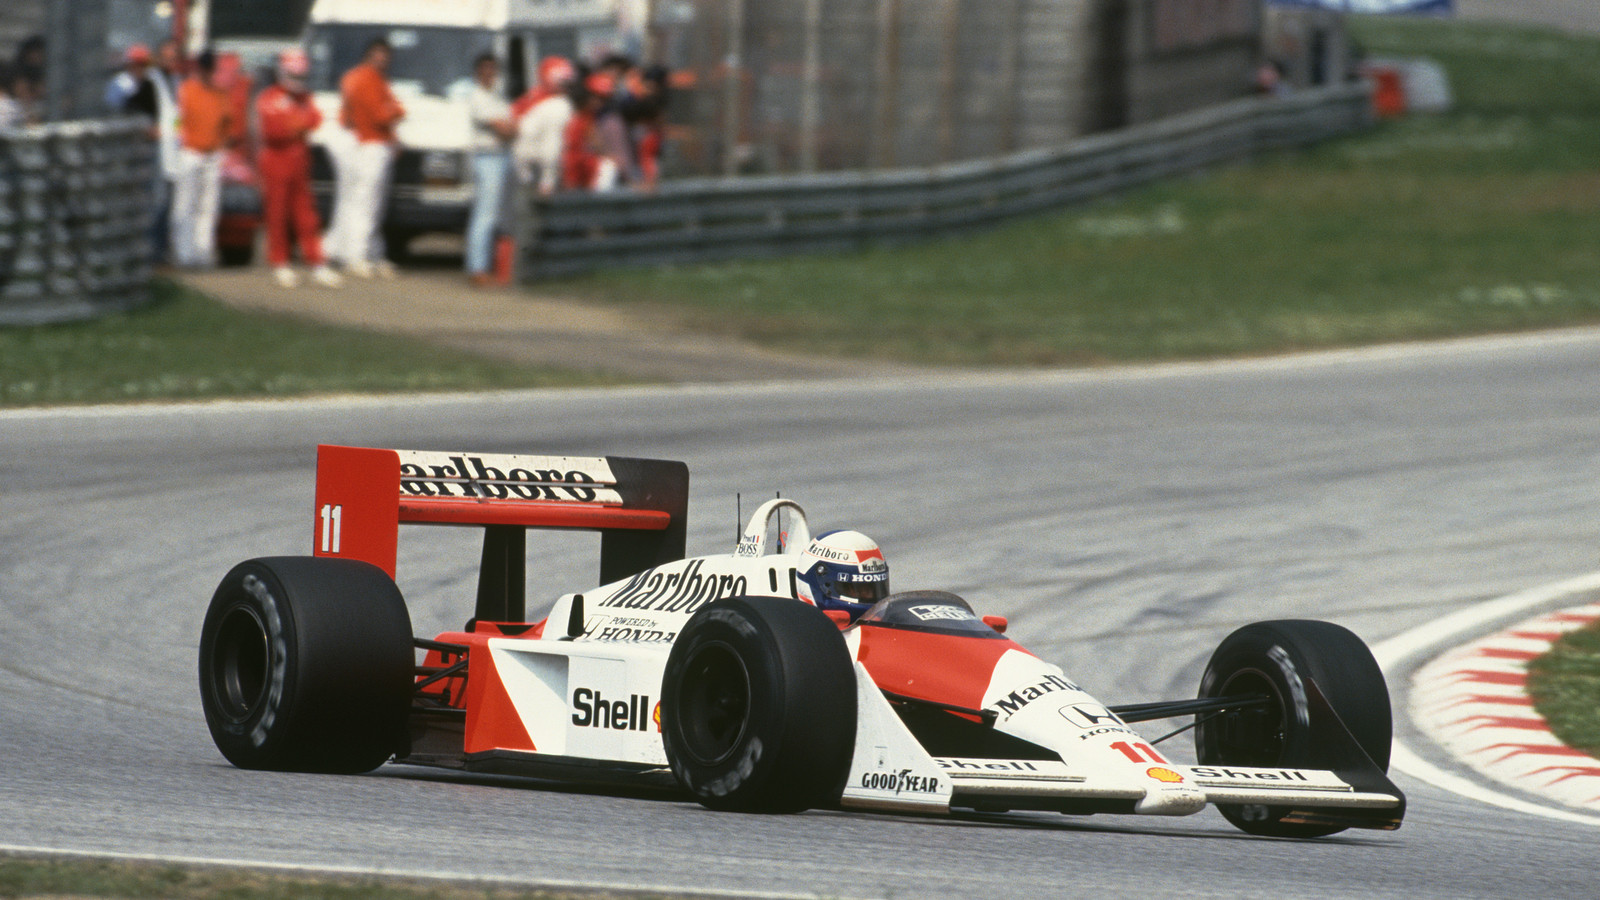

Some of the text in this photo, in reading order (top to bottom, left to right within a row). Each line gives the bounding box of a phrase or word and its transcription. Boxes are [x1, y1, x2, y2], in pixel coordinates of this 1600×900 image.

[400, 456, 597, 501] arlboro
[321, 504, 341, 553] 11
[738, 542, 757, 555] BOSS
[808, 543, 850, 561] Marlboro
[851, 573, 889, 582] HOND
[609, 616, 650, 627] POWERED
[596, 627, 677, 643] HONDA
[572, 687, 649, 731] Shell
[1109, 741, 1168, 764] 11
[1190, 767, 1308, 782] Shell
